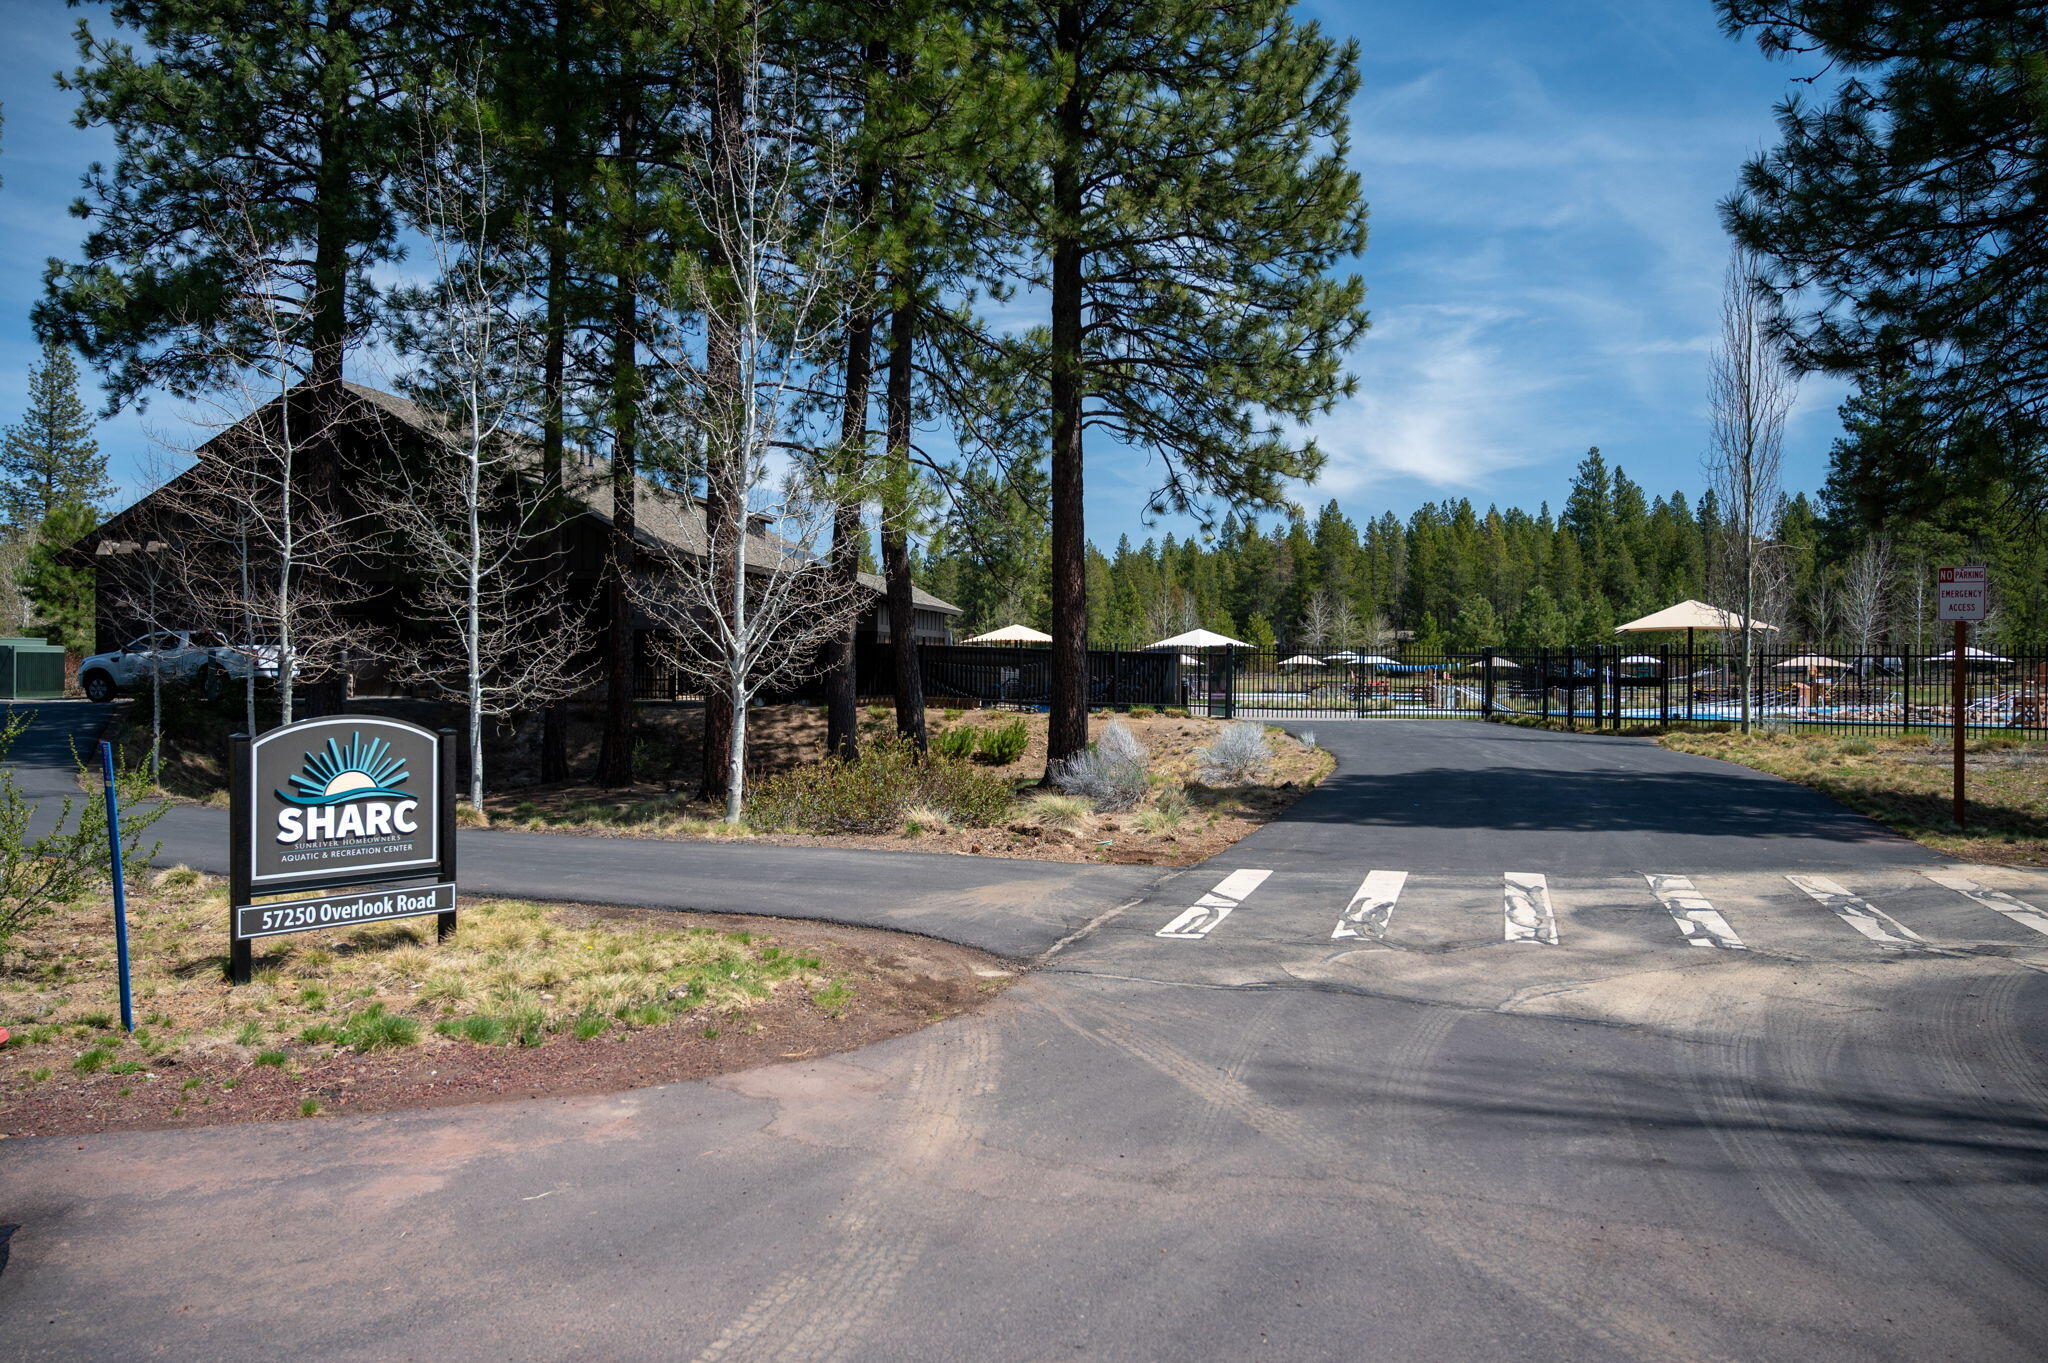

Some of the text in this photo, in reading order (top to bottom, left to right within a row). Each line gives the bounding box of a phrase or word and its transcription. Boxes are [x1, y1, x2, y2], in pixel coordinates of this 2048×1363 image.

[1940, 571, 1984, 580] NO PARKING
[1941, 590, 1983, 598] EMERGENCY
[1949, 604, 1976, 612] ACCESS
[276, 799, 418, 843] SHARC
[294, 835, 401, 850] SUNRIVER HOMEOWNERS
[281, 844, 413, 862] AQUATIC & RECREATION CENTER
[262, 890, 436, 930] 57250 Overlook Road
